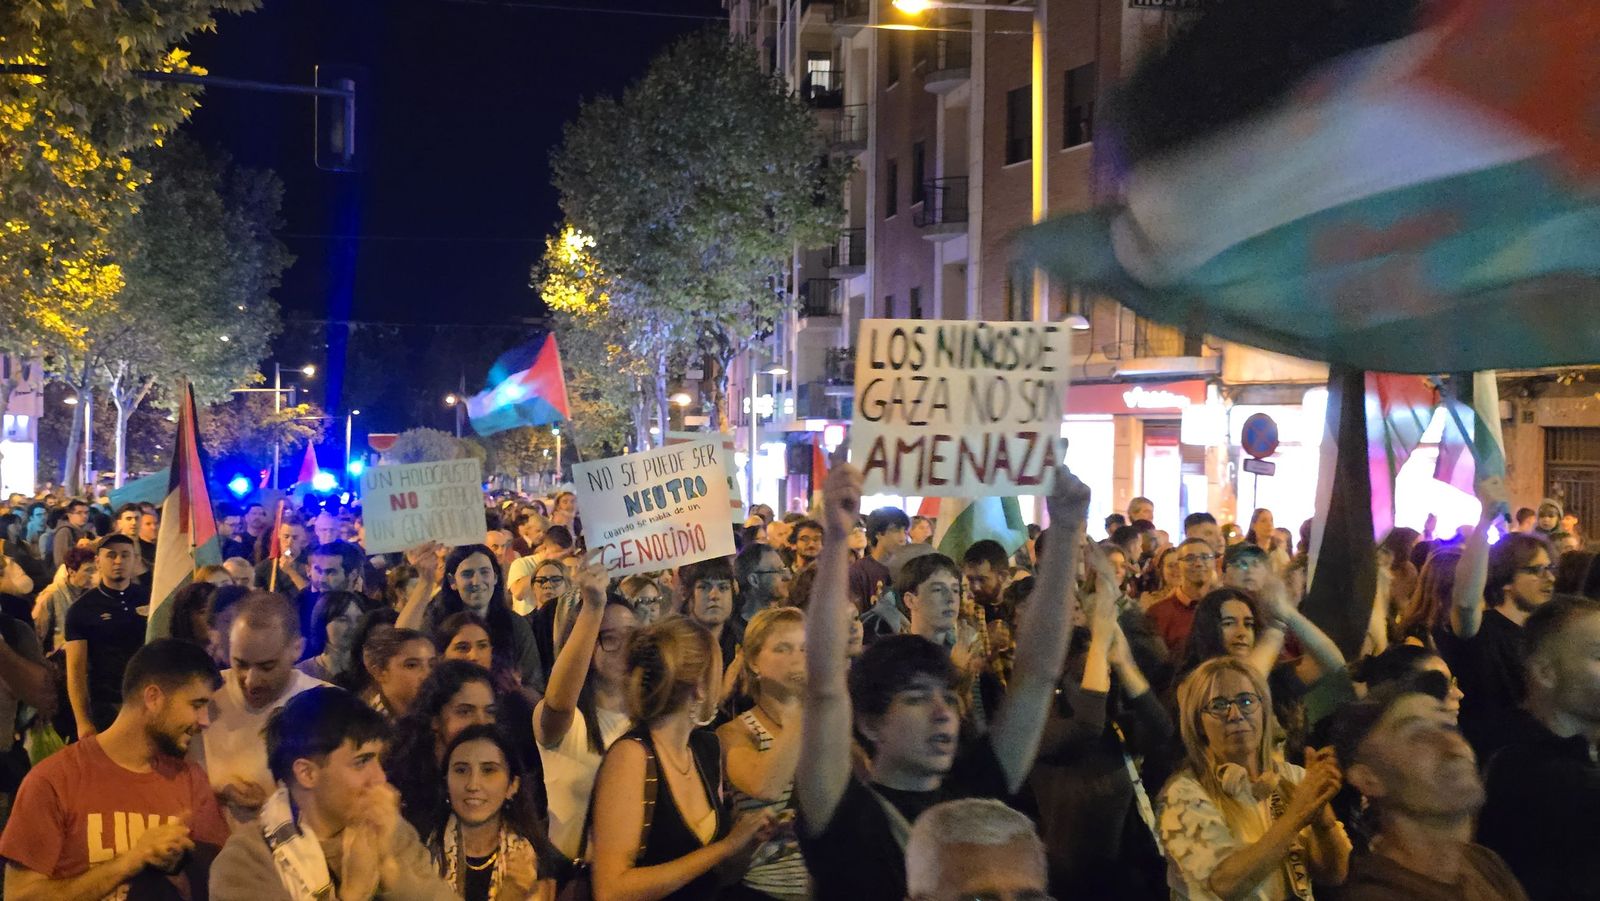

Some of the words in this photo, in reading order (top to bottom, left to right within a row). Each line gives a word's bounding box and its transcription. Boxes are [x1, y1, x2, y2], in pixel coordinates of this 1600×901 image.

[870, 326, 926, 371] LOS
[934, 322, 1021, 371] NIÑOS
[1024, 326, 1060, 372] DE
[860, 376, 951, 426] GAZA
[964, 375, 1011, 425] NO
[1018, 377, 1064, 425] SON
[366, 471, 392, 489] UN
[587, 465, 614, 492] NO
[621, 461, 638, 486] SE
[643, 451, 685, 481] PUEDE
[692, 443, 717, 470] SER
[862, 431, 1058, 489] AMENAZA
[389, 491, 419, 511] NO
[623, 475, 707, 517] NEUTRO
[674, 506, 685, 515] de
[688, 503, 701, 511] un
[370, 519, 395, 541] UN
[88, 811, 181, 862] LIN
